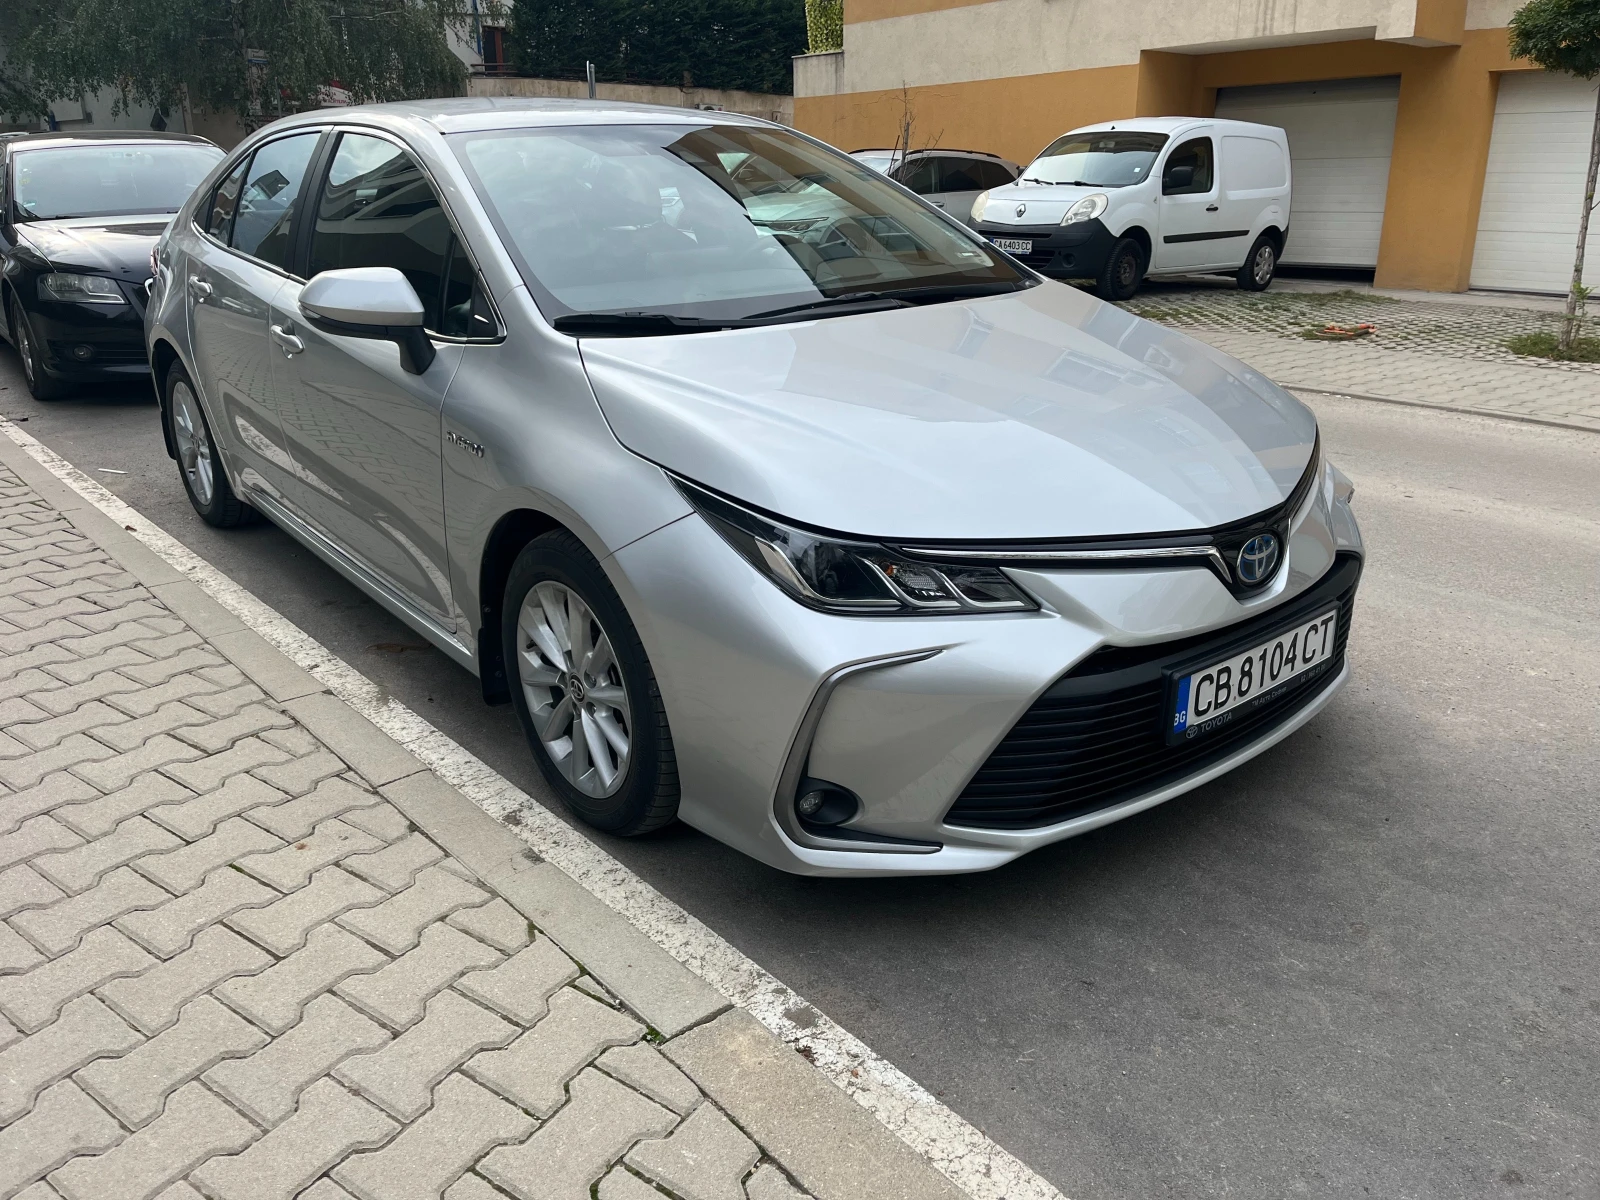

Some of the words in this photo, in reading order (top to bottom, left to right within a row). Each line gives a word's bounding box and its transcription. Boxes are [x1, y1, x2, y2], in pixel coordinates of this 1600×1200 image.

[1003, 241, 1020, 250] 6403
[1194, 665, 1232, 717] CB
[1237, 632, 1299, 697] 8104
[1303, 615, 1334, 664] CT
[1174, 710, 1186, 727] BG
[1201, 712, 1232, 733] TOYOTA
